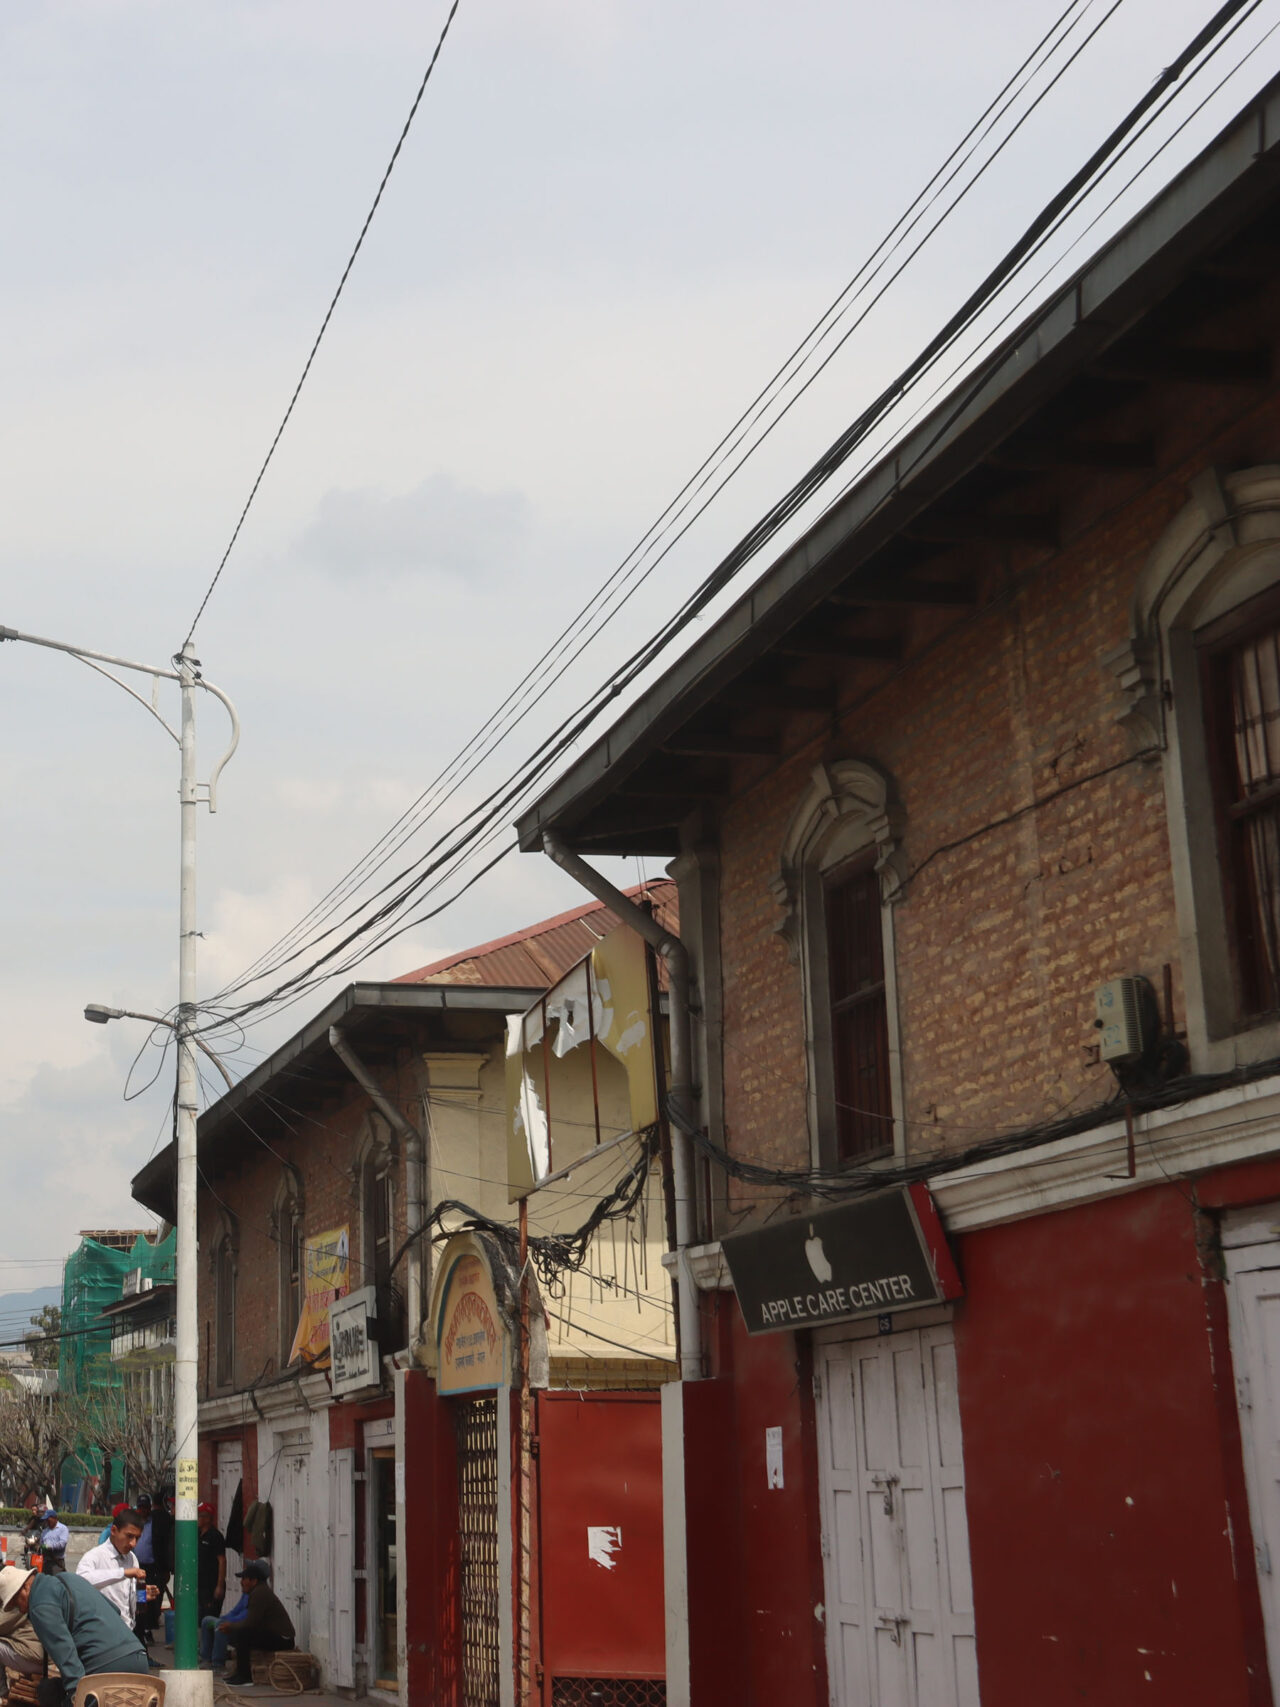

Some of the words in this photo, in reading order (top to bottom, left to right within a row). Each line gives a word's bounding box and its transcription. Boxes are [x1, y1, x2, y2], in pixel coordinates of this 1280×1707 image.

[760, 1296, 807, 1324] APPLE
[806, 1288, 850, 1315] CARE
[849, 1274, 915, 1307] CENTER
